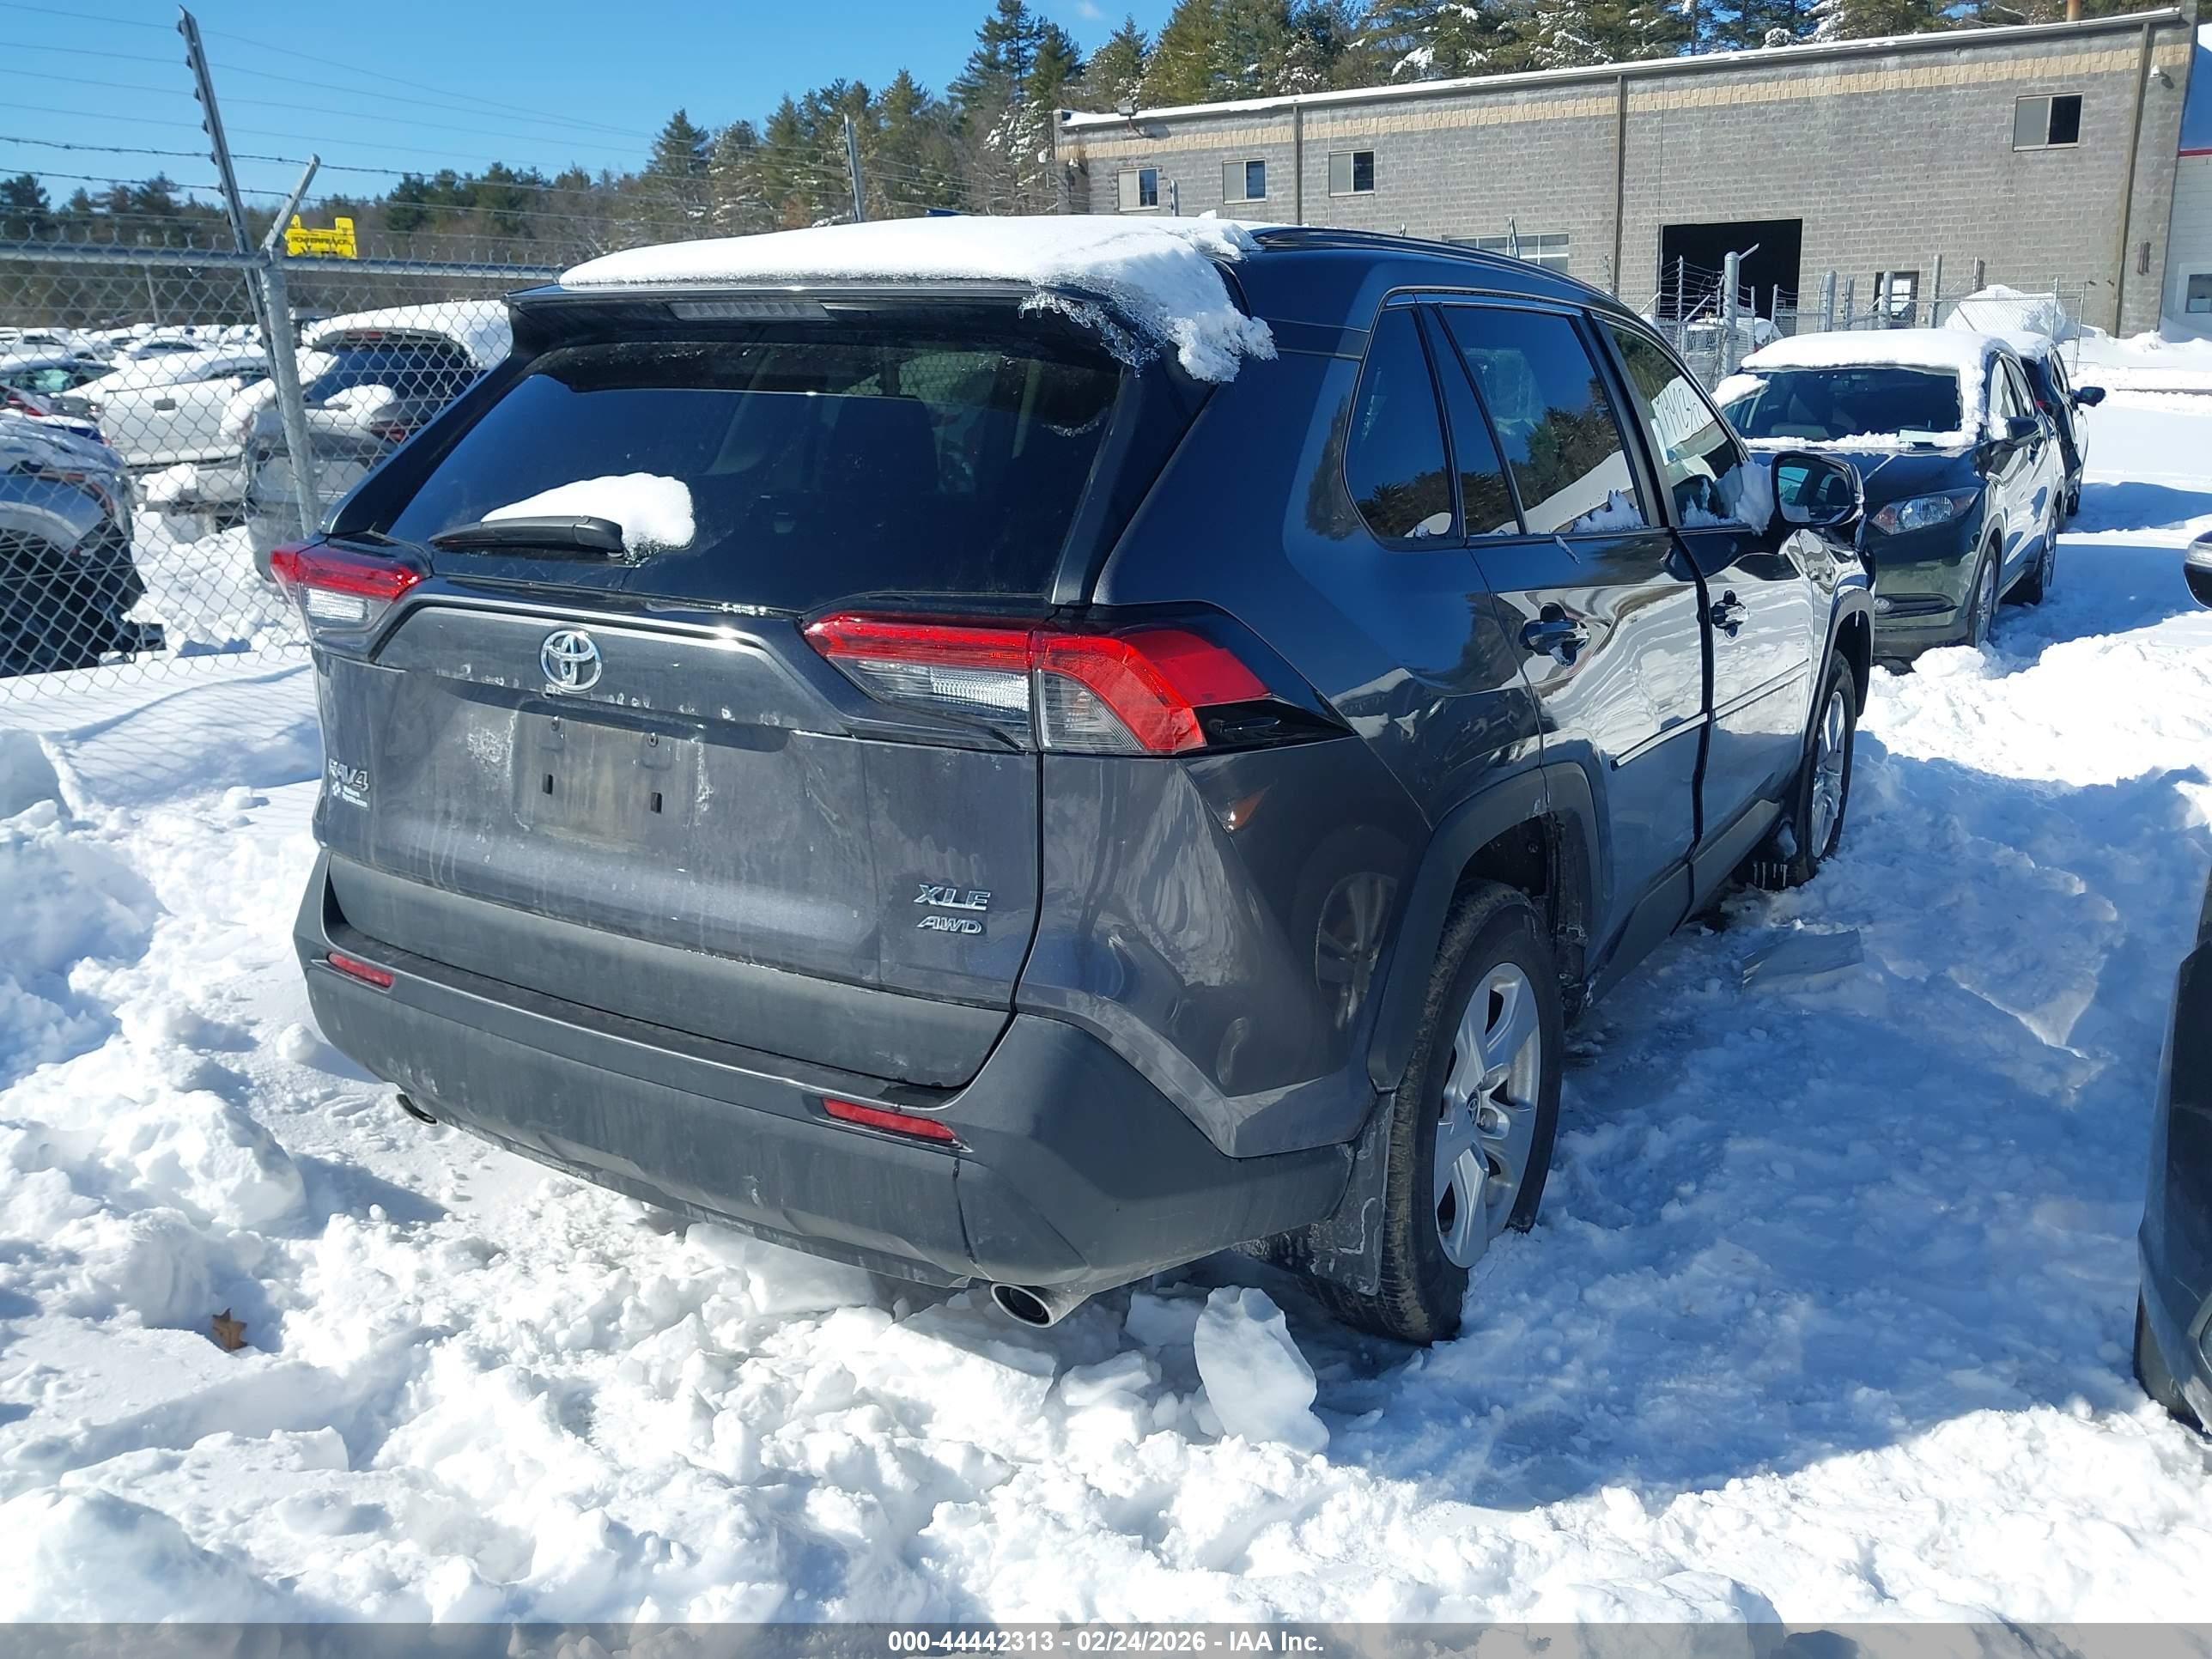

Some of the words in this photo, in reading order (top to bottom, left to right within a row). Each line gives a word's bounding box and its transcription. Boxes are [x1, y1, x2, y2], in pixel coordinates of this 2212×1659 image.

[327, 757, 369, 792] RAV4
[913, 884, 991, 911] XLE
[916, 915, 982, 934] AWD
